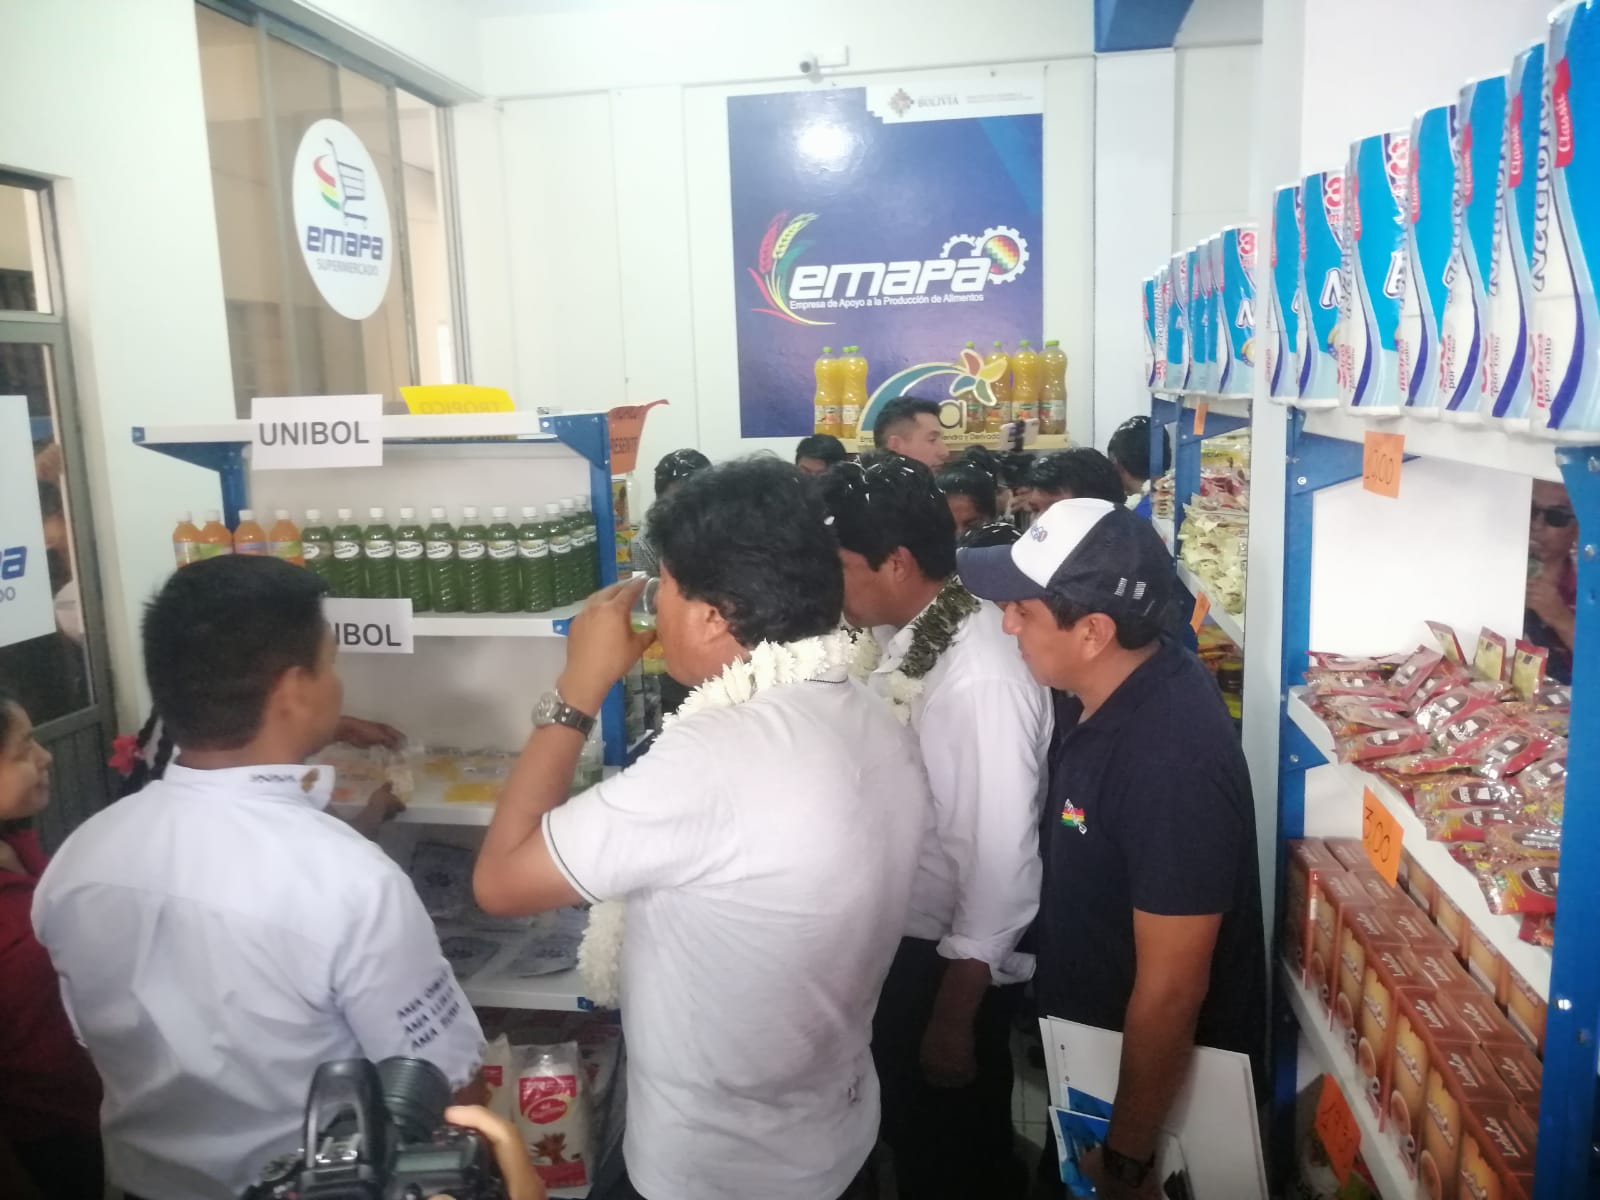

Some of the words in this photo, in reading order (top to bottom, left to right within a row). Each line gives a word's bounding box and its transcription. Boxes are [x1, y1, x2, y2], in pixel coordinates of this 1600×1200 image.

[306, 225, 384, 261] emapa
[788, 256, 992, 299] emapa
[790, 301, 826, 311] Empresa
[827, 299, 838, 309] de
[839, 298, 865, 310] Apoyo
[874, 297, 882, 306] la
[884, 294, 930, 306] Producción
[931, 294, 942, 304] de
[943, 293, 985, 303] Alimentos
[258, 420, 370, 447] UNIBOL
[334, 622, 403, 647] IBOL
